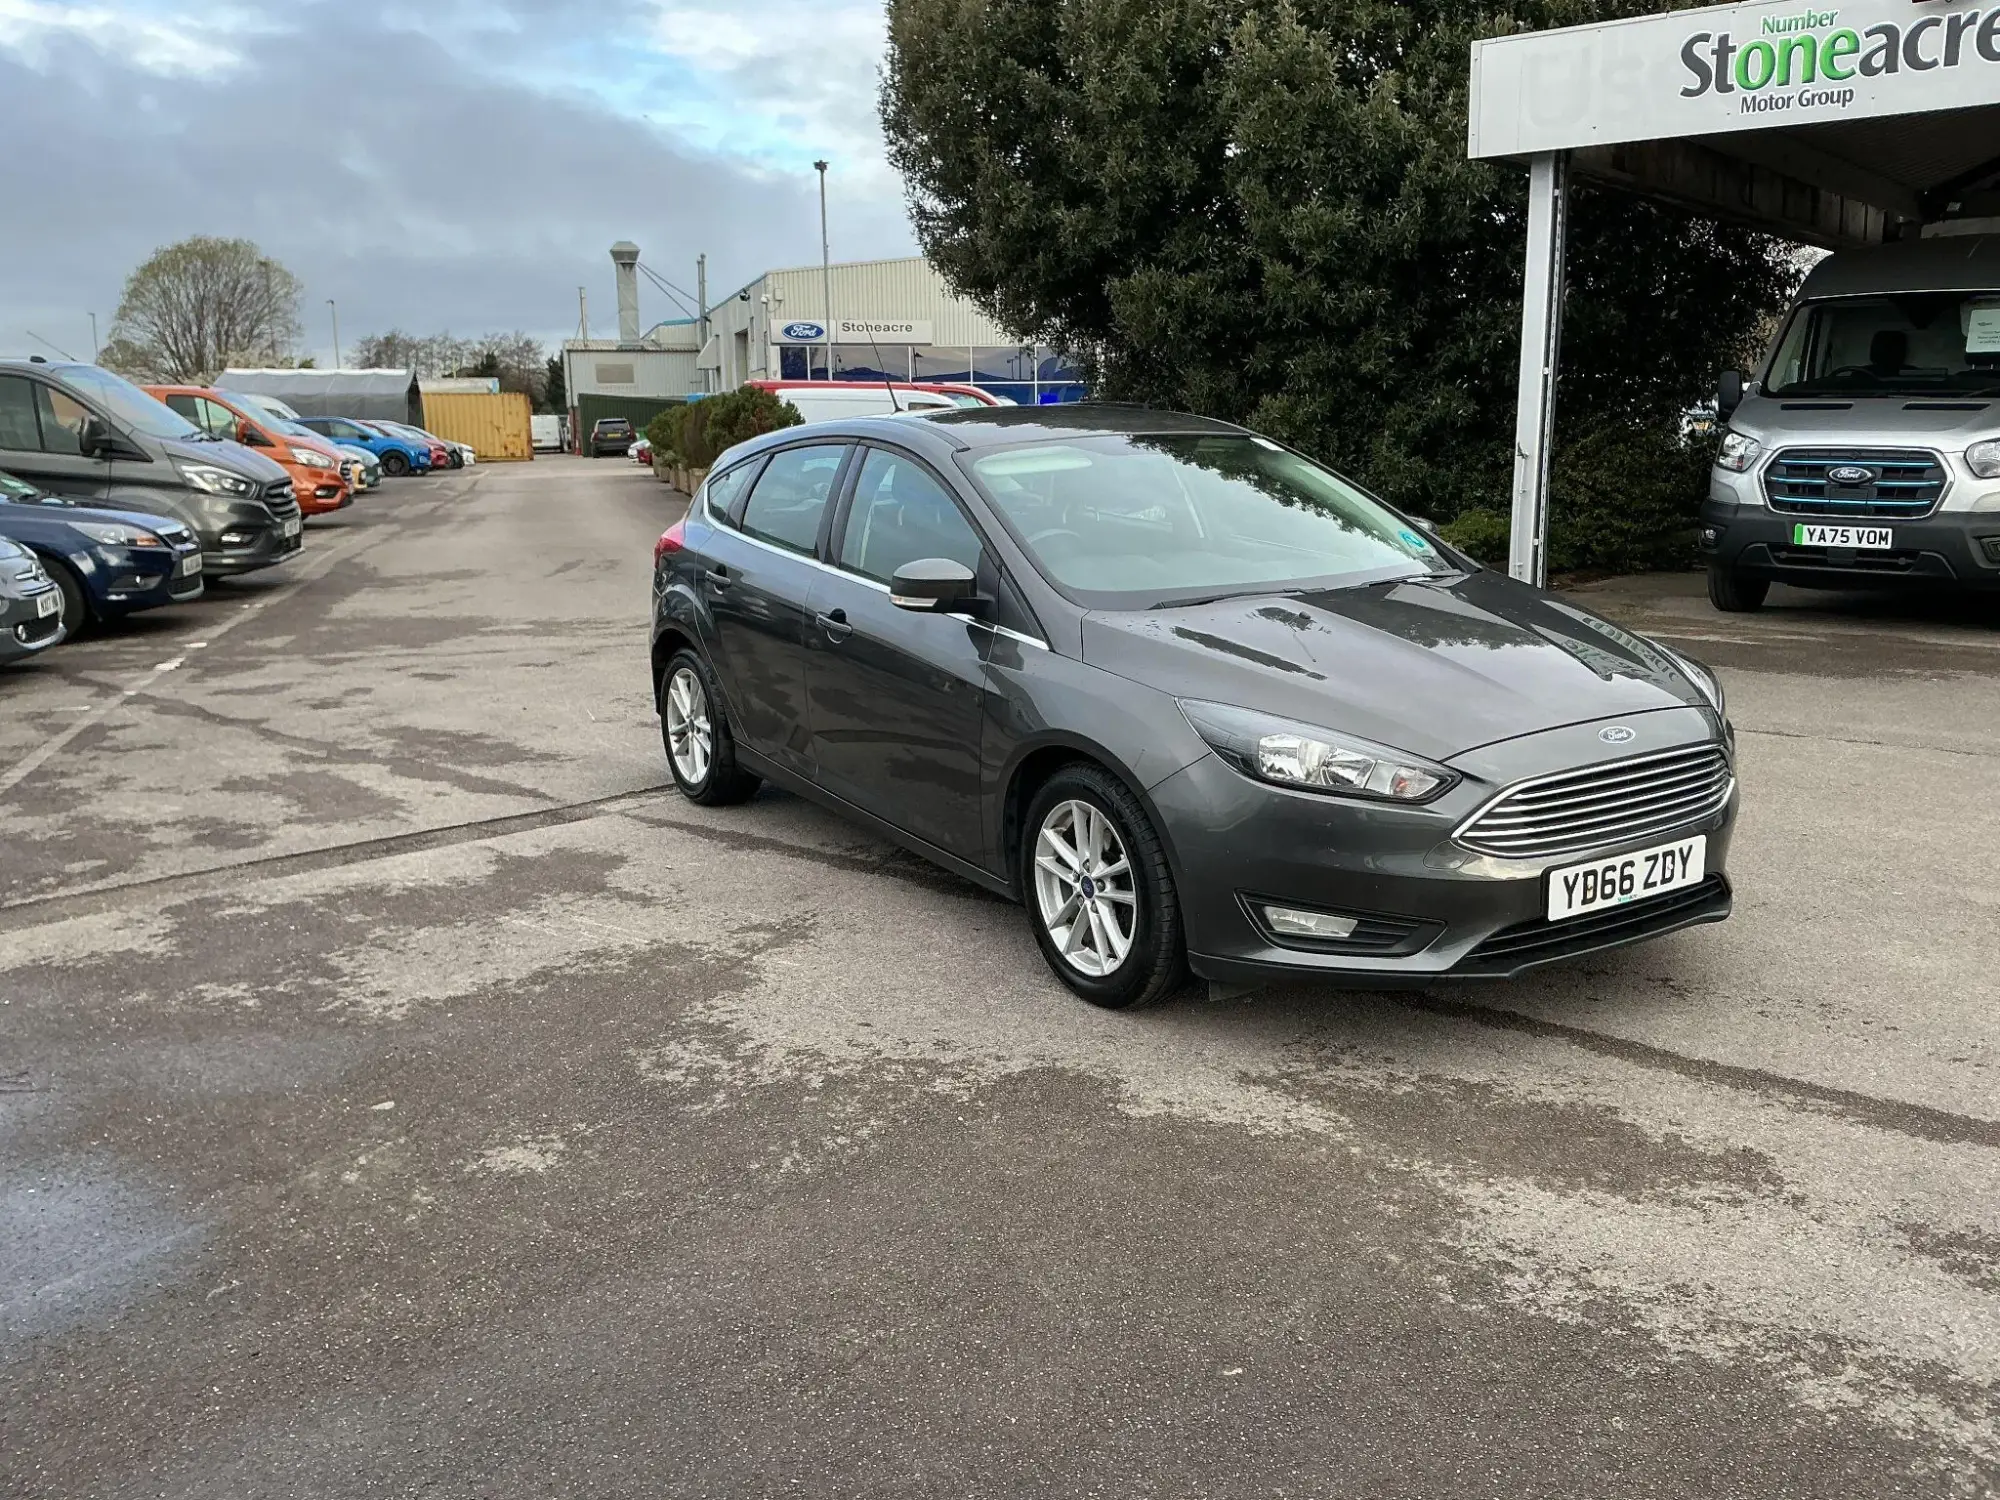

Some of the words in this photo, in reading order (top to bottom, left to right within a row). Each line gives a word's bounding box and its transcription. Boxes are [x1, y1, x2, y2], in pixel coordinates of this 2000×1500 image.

[1762, 9, 1838, 34] Number
[1740, 92, 1792, 114] Motor
[1798, 87, 1855, 108] Group
[790, 324, 817, 338] Ford
[841, 321, 913, 333] Stoneacre
[1836, 467, 1861, 479] Ford
[1807, 527, 1850, 544] YA75
[1856, 529, 1889, 546] VOM
[1606, 729, 1629, 740] Ford
[1563, 860, 1635, 909] YD66
[1643, 844, 1693, 890] ZDY
